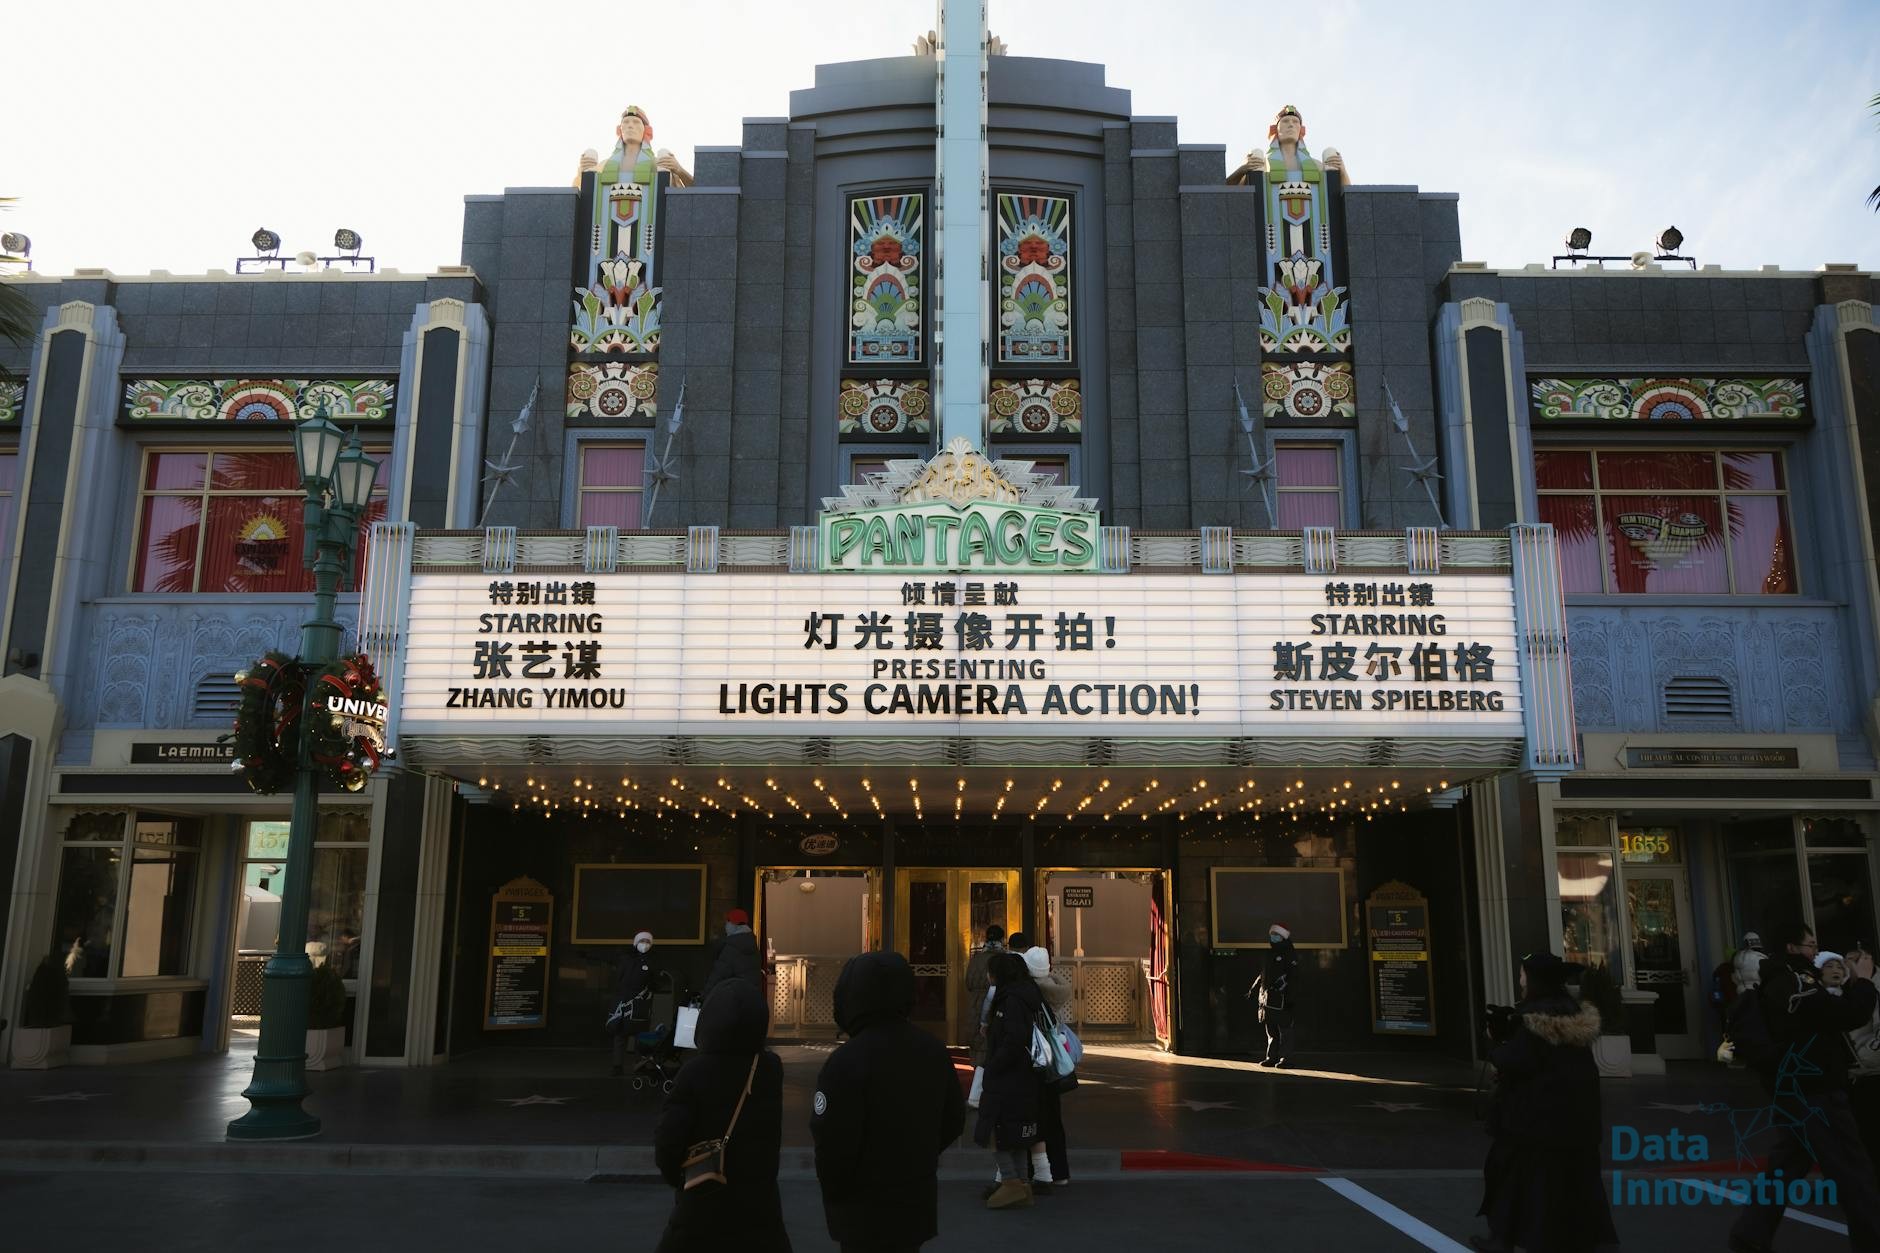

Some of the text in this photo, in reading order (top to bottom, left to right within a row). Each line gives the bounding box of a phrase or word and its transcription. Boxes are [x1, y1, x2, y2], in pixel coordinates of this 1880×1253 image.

[830, 510, 1094, 565] PANTAGES
[489, 581, 596, 606] 特别出镜
[901, 581, 1019, 606] 倾情呈献
[1325, 581, 1435, 607] 特别出镜
[479, 613, 603, 634] STARRING
[1311, 614, 1447, 636] STARRING
[474, 640, 602, 680] 张艺谋
[874, 659, 1046, 680] PRESENTING
[1273, 641, 1495, 682] 斯皮尔伯格
[446, 688, 626, 709] ZHANG YIMOU
[720, 683, 1200, 716] LIGHTS CAMERA ACTION!
[1270, 689, 1504, 712] STEVEN SPIELBERG
[158, 745, 234, 757] LAEMMLE
[257, 831, 290, 850] 157
[1620, 834, 1670, 854] 1655
